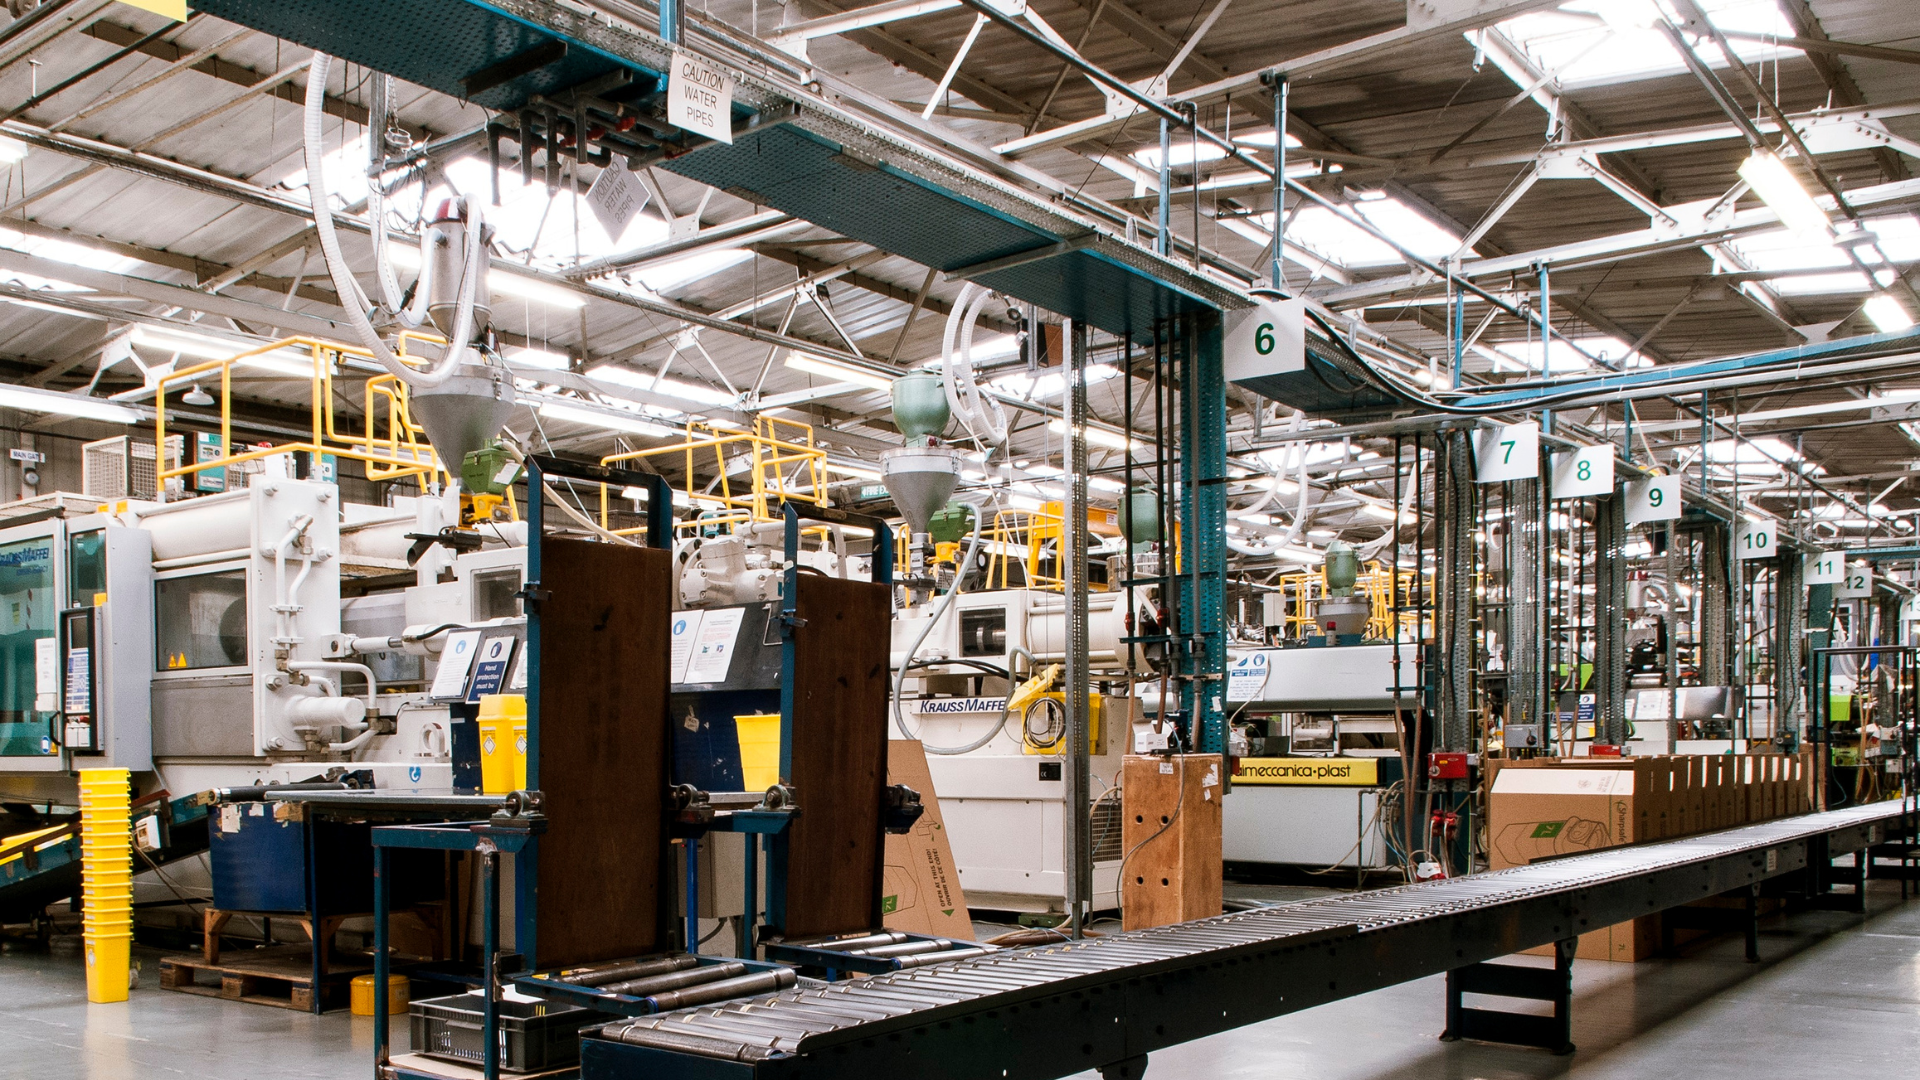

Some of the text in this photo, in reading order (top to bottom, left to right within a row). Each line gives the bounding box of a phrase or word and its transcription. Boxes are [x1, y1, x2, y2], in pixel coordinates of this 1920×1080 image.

[682, 62, 724, 91] CAUTION
[684, 84, 717, 109] WATER
[686, 106, 714, 128] PIPES
[1255, 322, 1276, 356] 6
[27, 452, 40, 460] GAT
[1500, 440, 1516, 465] 7
[1577, 460, 1592, 481] 8
[1649, 487, 1664, 508] 9
[1743, 531, 1767, 550] 10
[1814, 560, 1833, 576] 11
[1844, 576, 1865, 590] 12
[476, 674, 500, 682] protection
[920, 698, 1006, 713] KRAUSSMAFFE
[1540, 823, 1556, 836] 7L
[1617, 807, 1627, 843] Sharpsafe
[926, 848, 934, 864] END!
[930, 865, 938, 880] THIS
[938, 866, 944, 874] CE
[940, 875, 946, 883] DE
[937, 890, 946, 907] OPEN
[942, 884, 952, 907] OUVRIR
[885, 899, 892, 910] 7L
